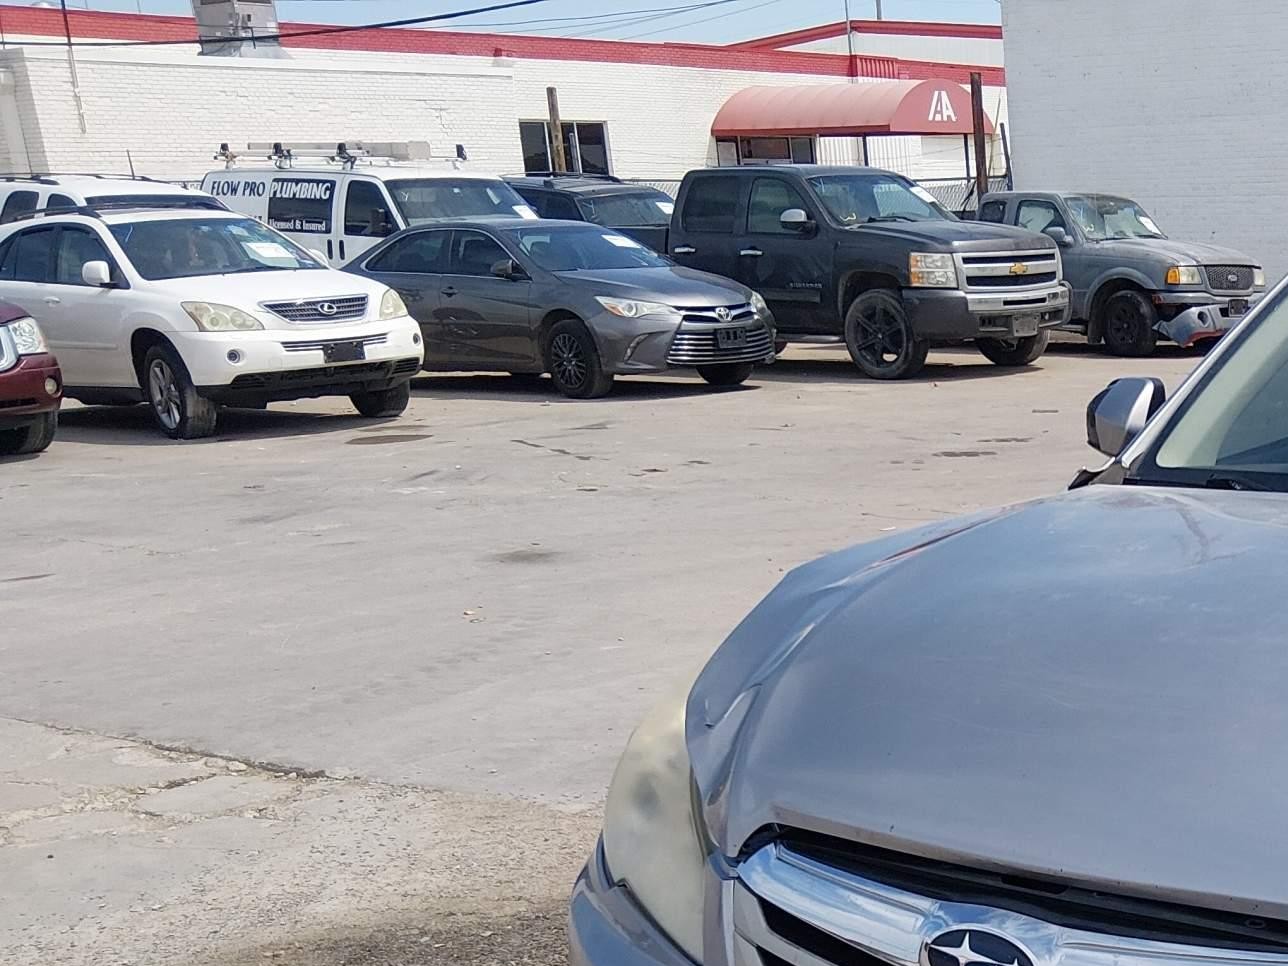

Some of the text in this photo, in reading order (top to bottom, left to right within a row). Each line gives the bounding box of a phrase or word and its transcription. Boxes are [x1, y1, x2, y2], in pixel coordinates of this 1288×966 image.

[210, 180, 332, 200] FLOW PRO PLUMBING
[303, 220, 326, 231] Insured
